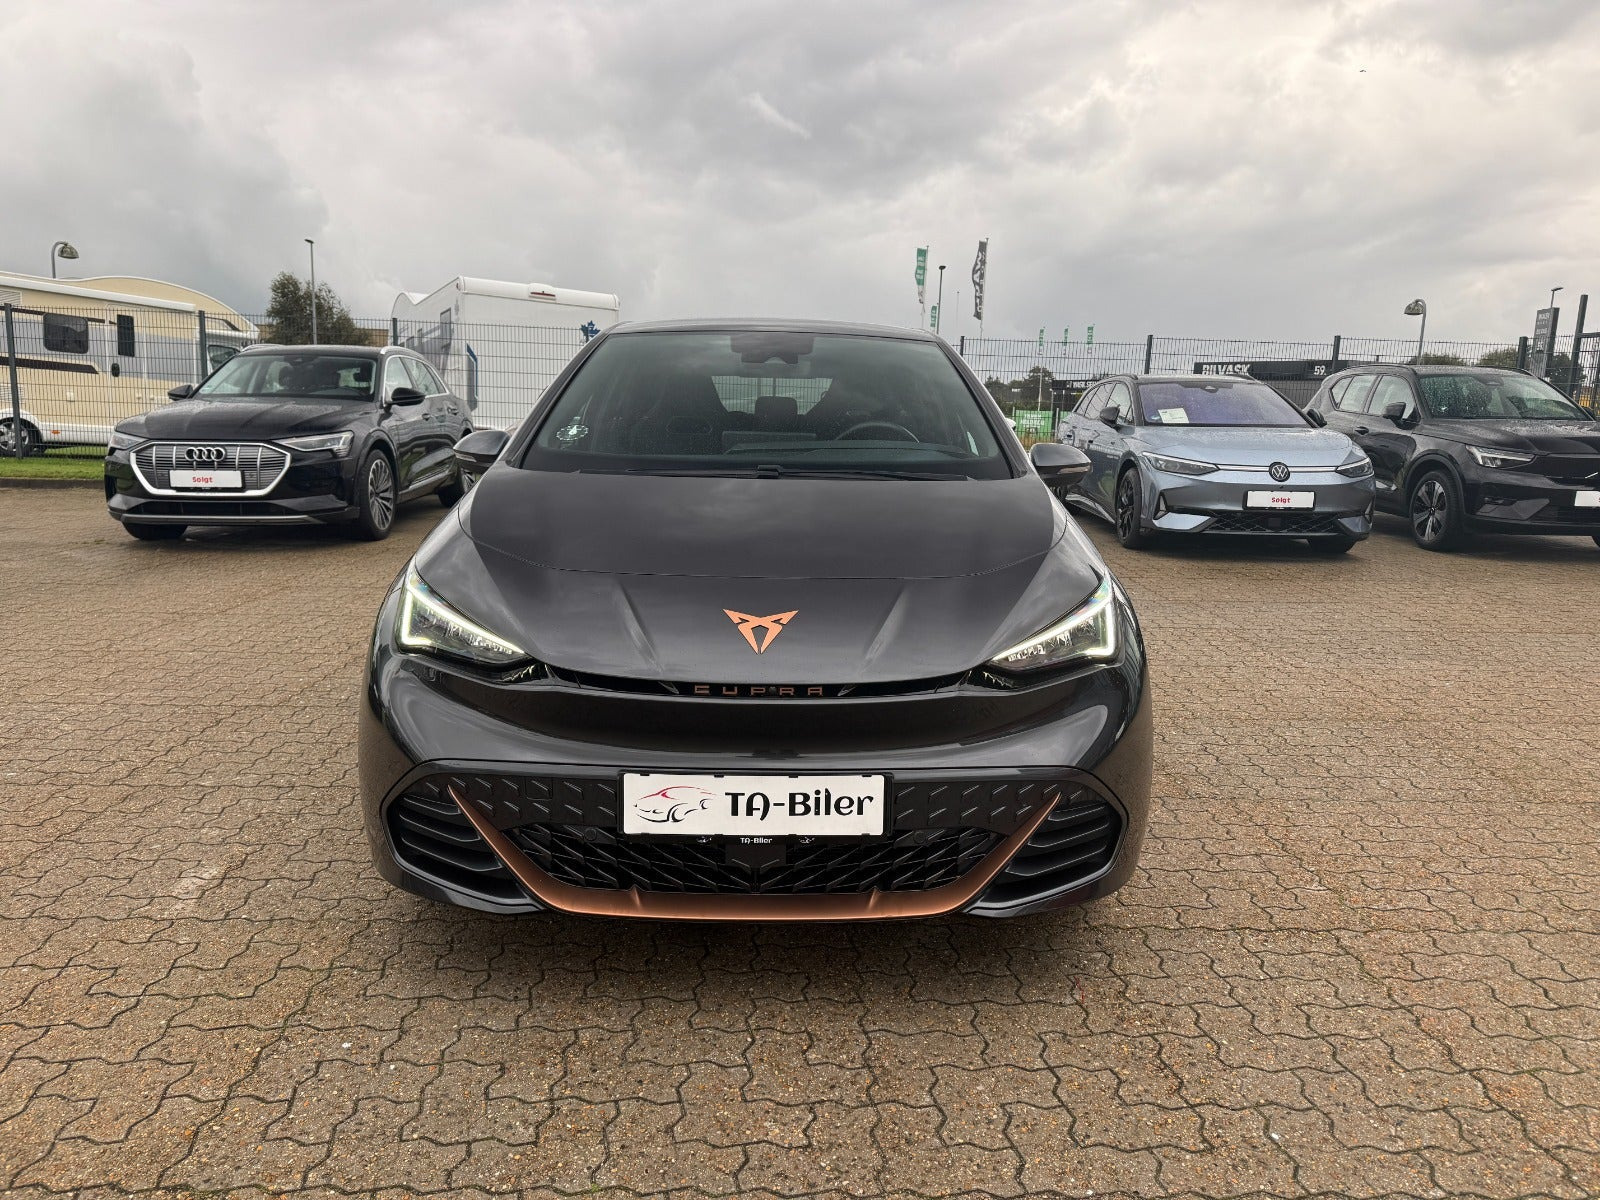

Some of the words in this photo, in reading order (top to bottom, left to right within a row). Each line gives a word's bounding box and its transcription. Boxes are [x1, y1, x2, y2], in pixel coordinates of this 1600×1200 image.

[1202, 364, 1250, 375] BILVASK
[694, 685, 823, 696] CUPRA
[724, 788, 874, 821] TA-Biler
